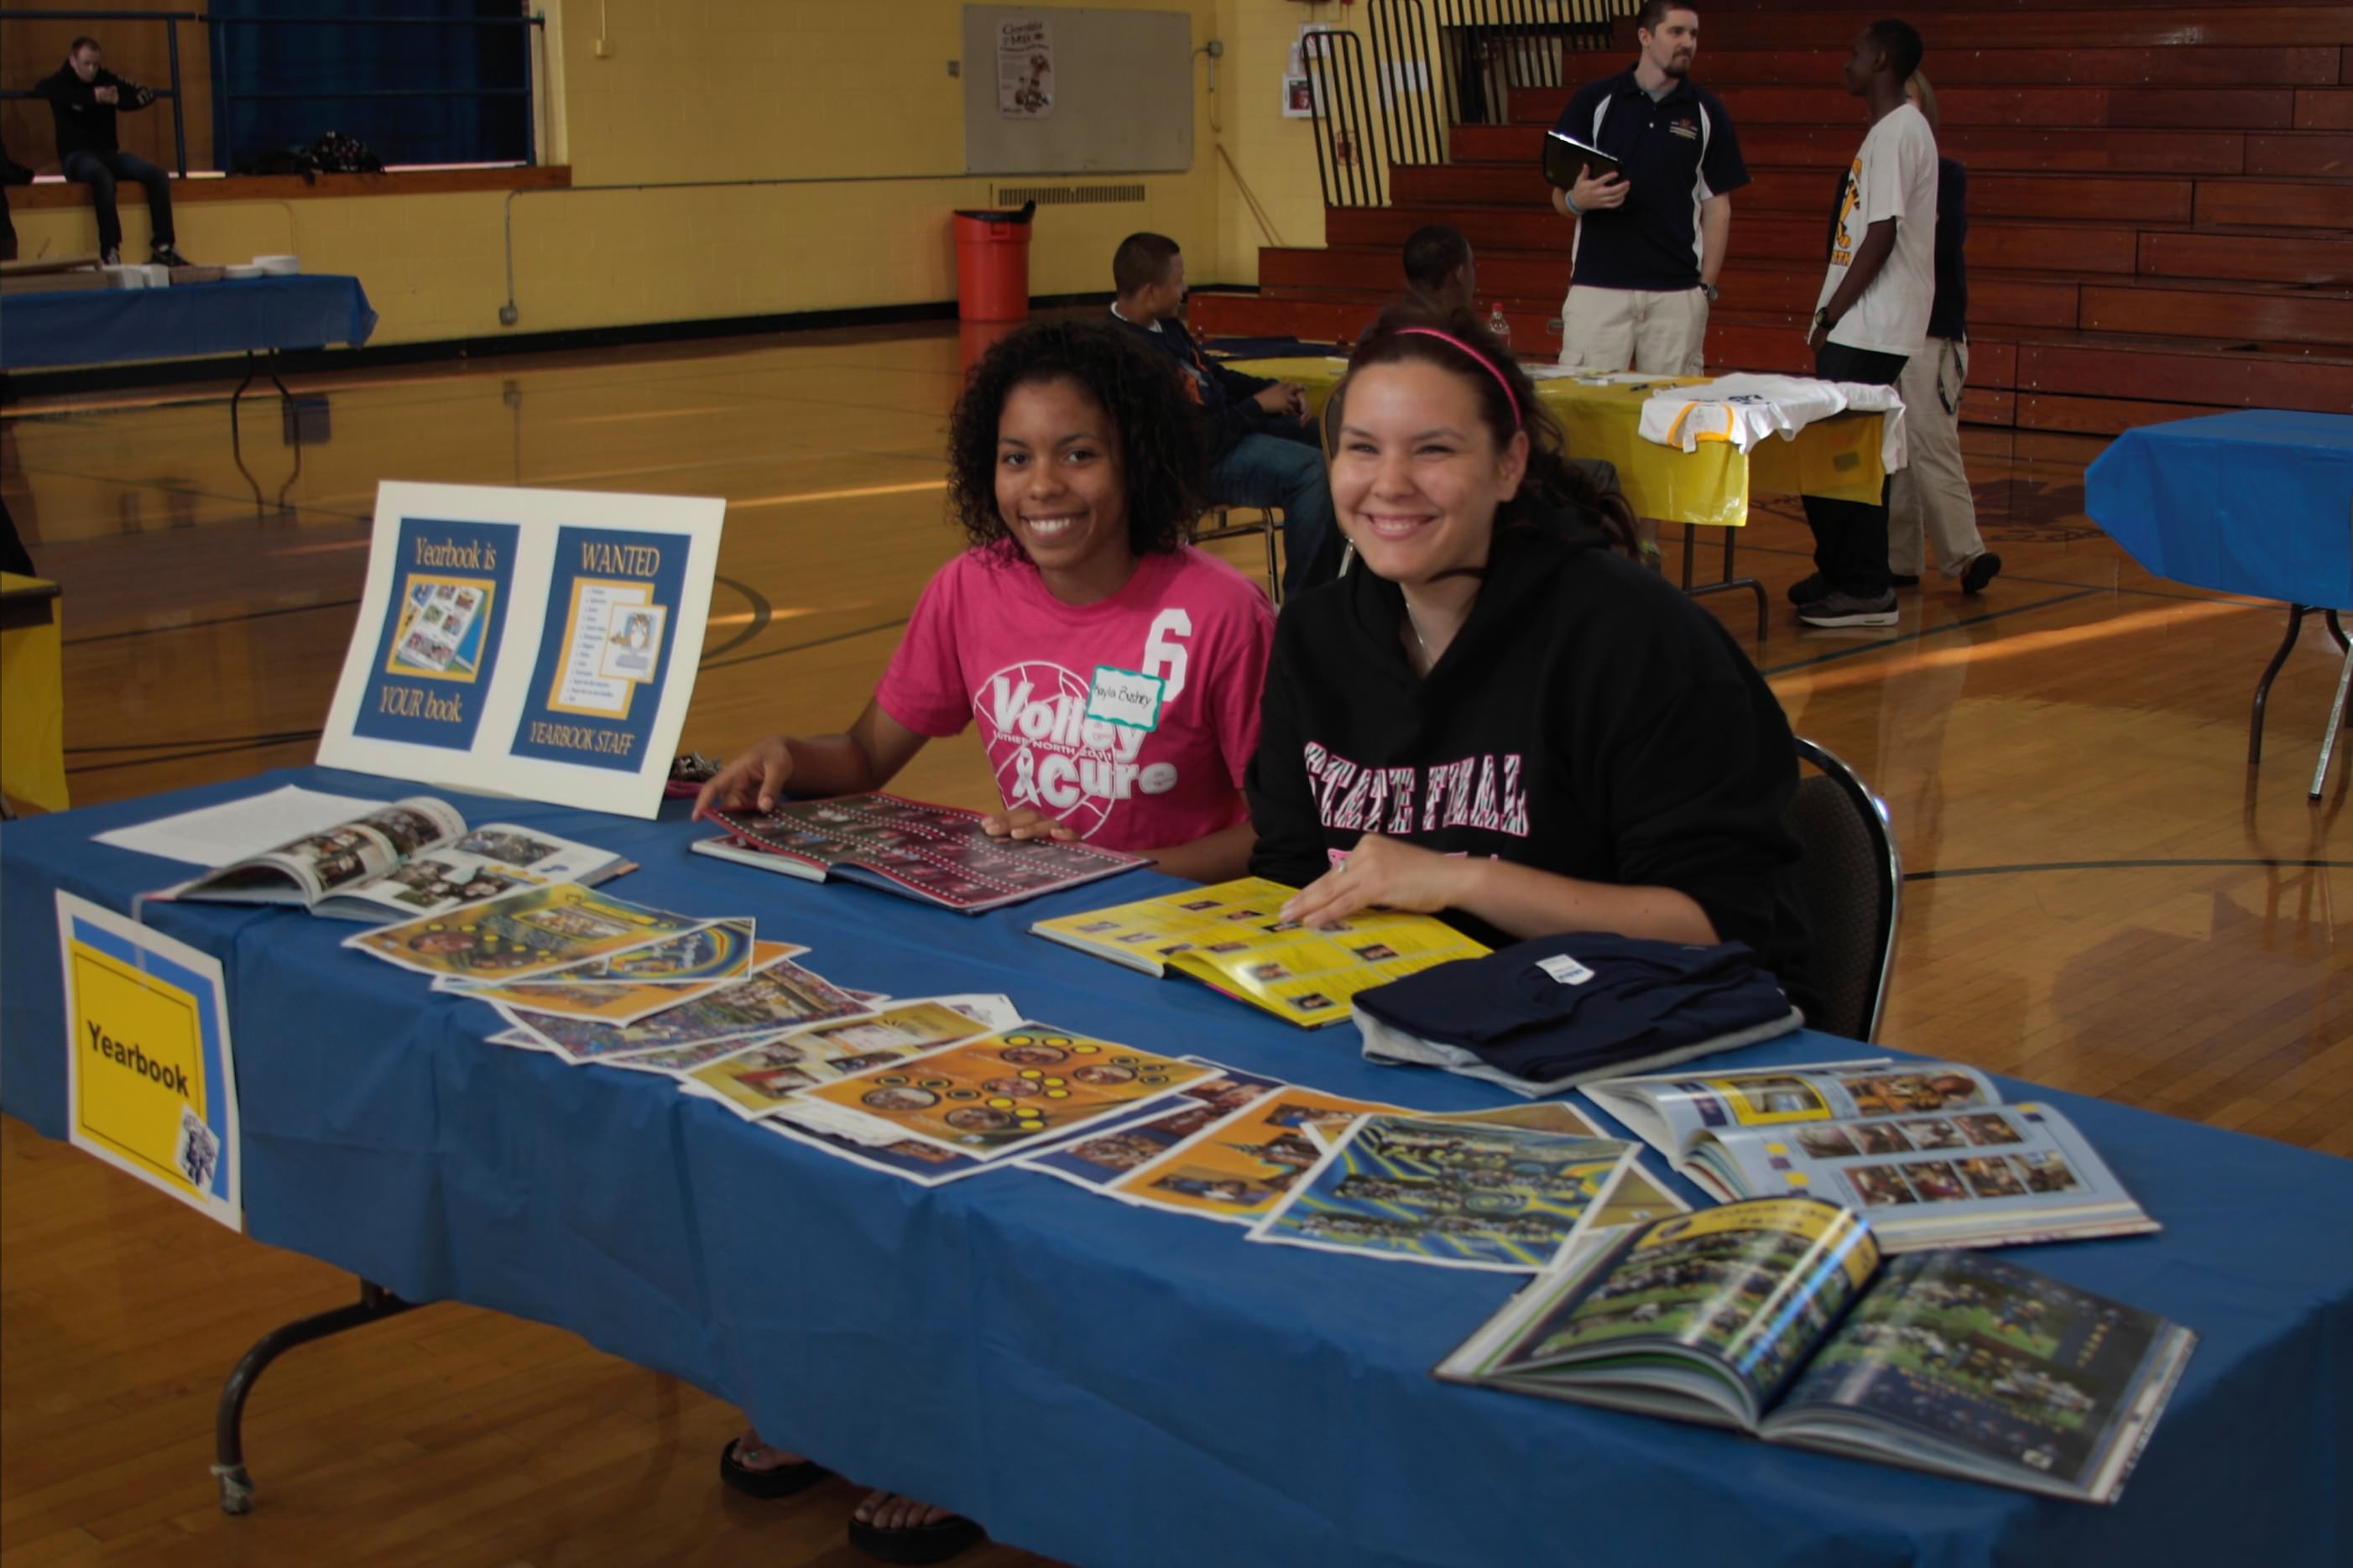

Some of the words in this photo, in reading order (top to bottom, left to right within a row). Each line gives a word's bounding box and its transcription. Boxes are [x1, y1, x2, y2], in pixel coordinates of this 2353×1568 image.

[415, 535, 481, 568] Yearbook
[483, 542, 497, 570] is
[581, 542, 660, 576] WANTED
[1142, 608, 1192, 703] 6
[379, 685, 424, 717] YOUR
[425, 690, 462, 722] book
[993, 675, 1148, 763] Volley
[530, 721, 595, 752] YEARBOOK
[596, 729, 634, 756] STAFF
[1033, 740, 1075, 754] NORTH
[1038, 753, 1177, 809] Cure
[1304, 741, 1415, 833] STATE
[87, 1018, 190, 1098] Yearbook
